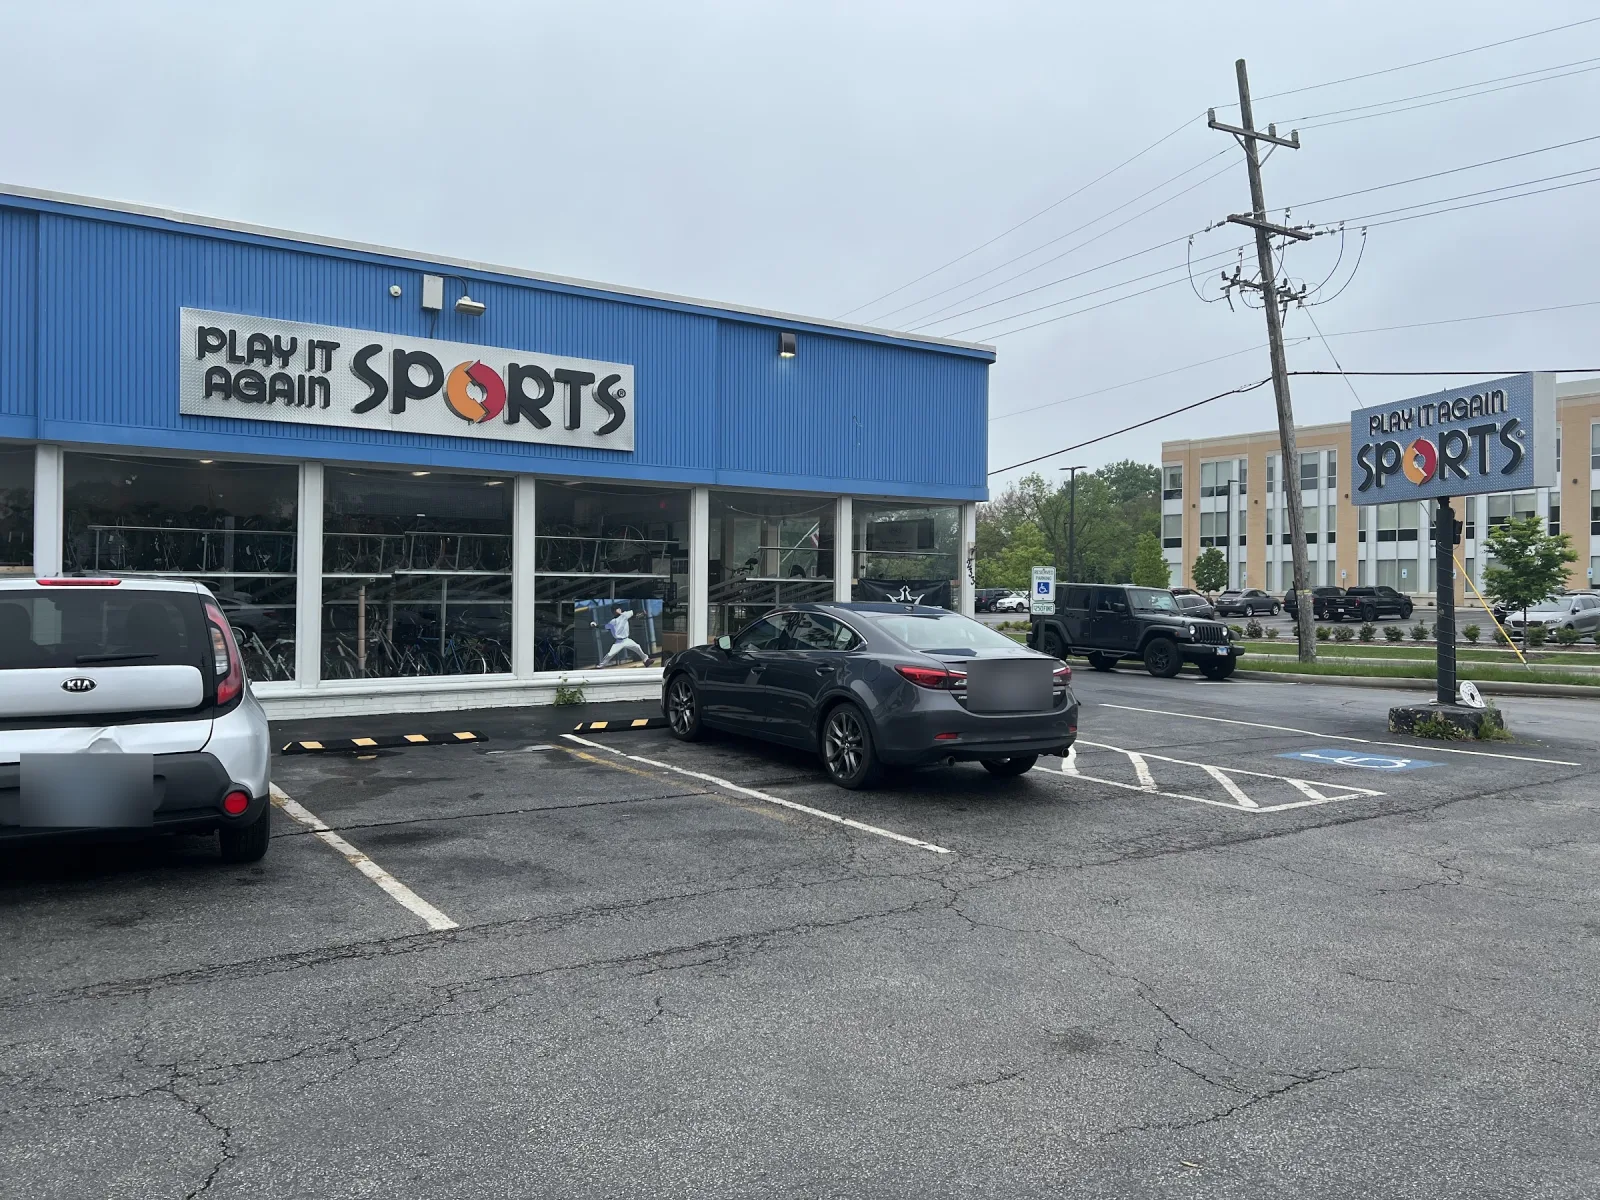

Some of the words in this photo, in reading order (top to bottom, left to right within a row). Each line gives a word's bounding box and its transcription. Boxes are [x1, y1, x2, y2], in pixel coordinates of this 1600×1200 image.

[196, 326, 297, 369] PLAY
[305, 339, 340, 373] IT
[204, 366, 331, 409] AGAIN
[350, 343, 627, 435] SPORTS
[1370, 407, 1415, 436] PLAY
[1418, 403, 1436, 427] IT
[1438, 389, 1508, 424] AGAIN
[1357, 417, 1526, 492] SPORTS
[67, 680, 91, 689] KIA
